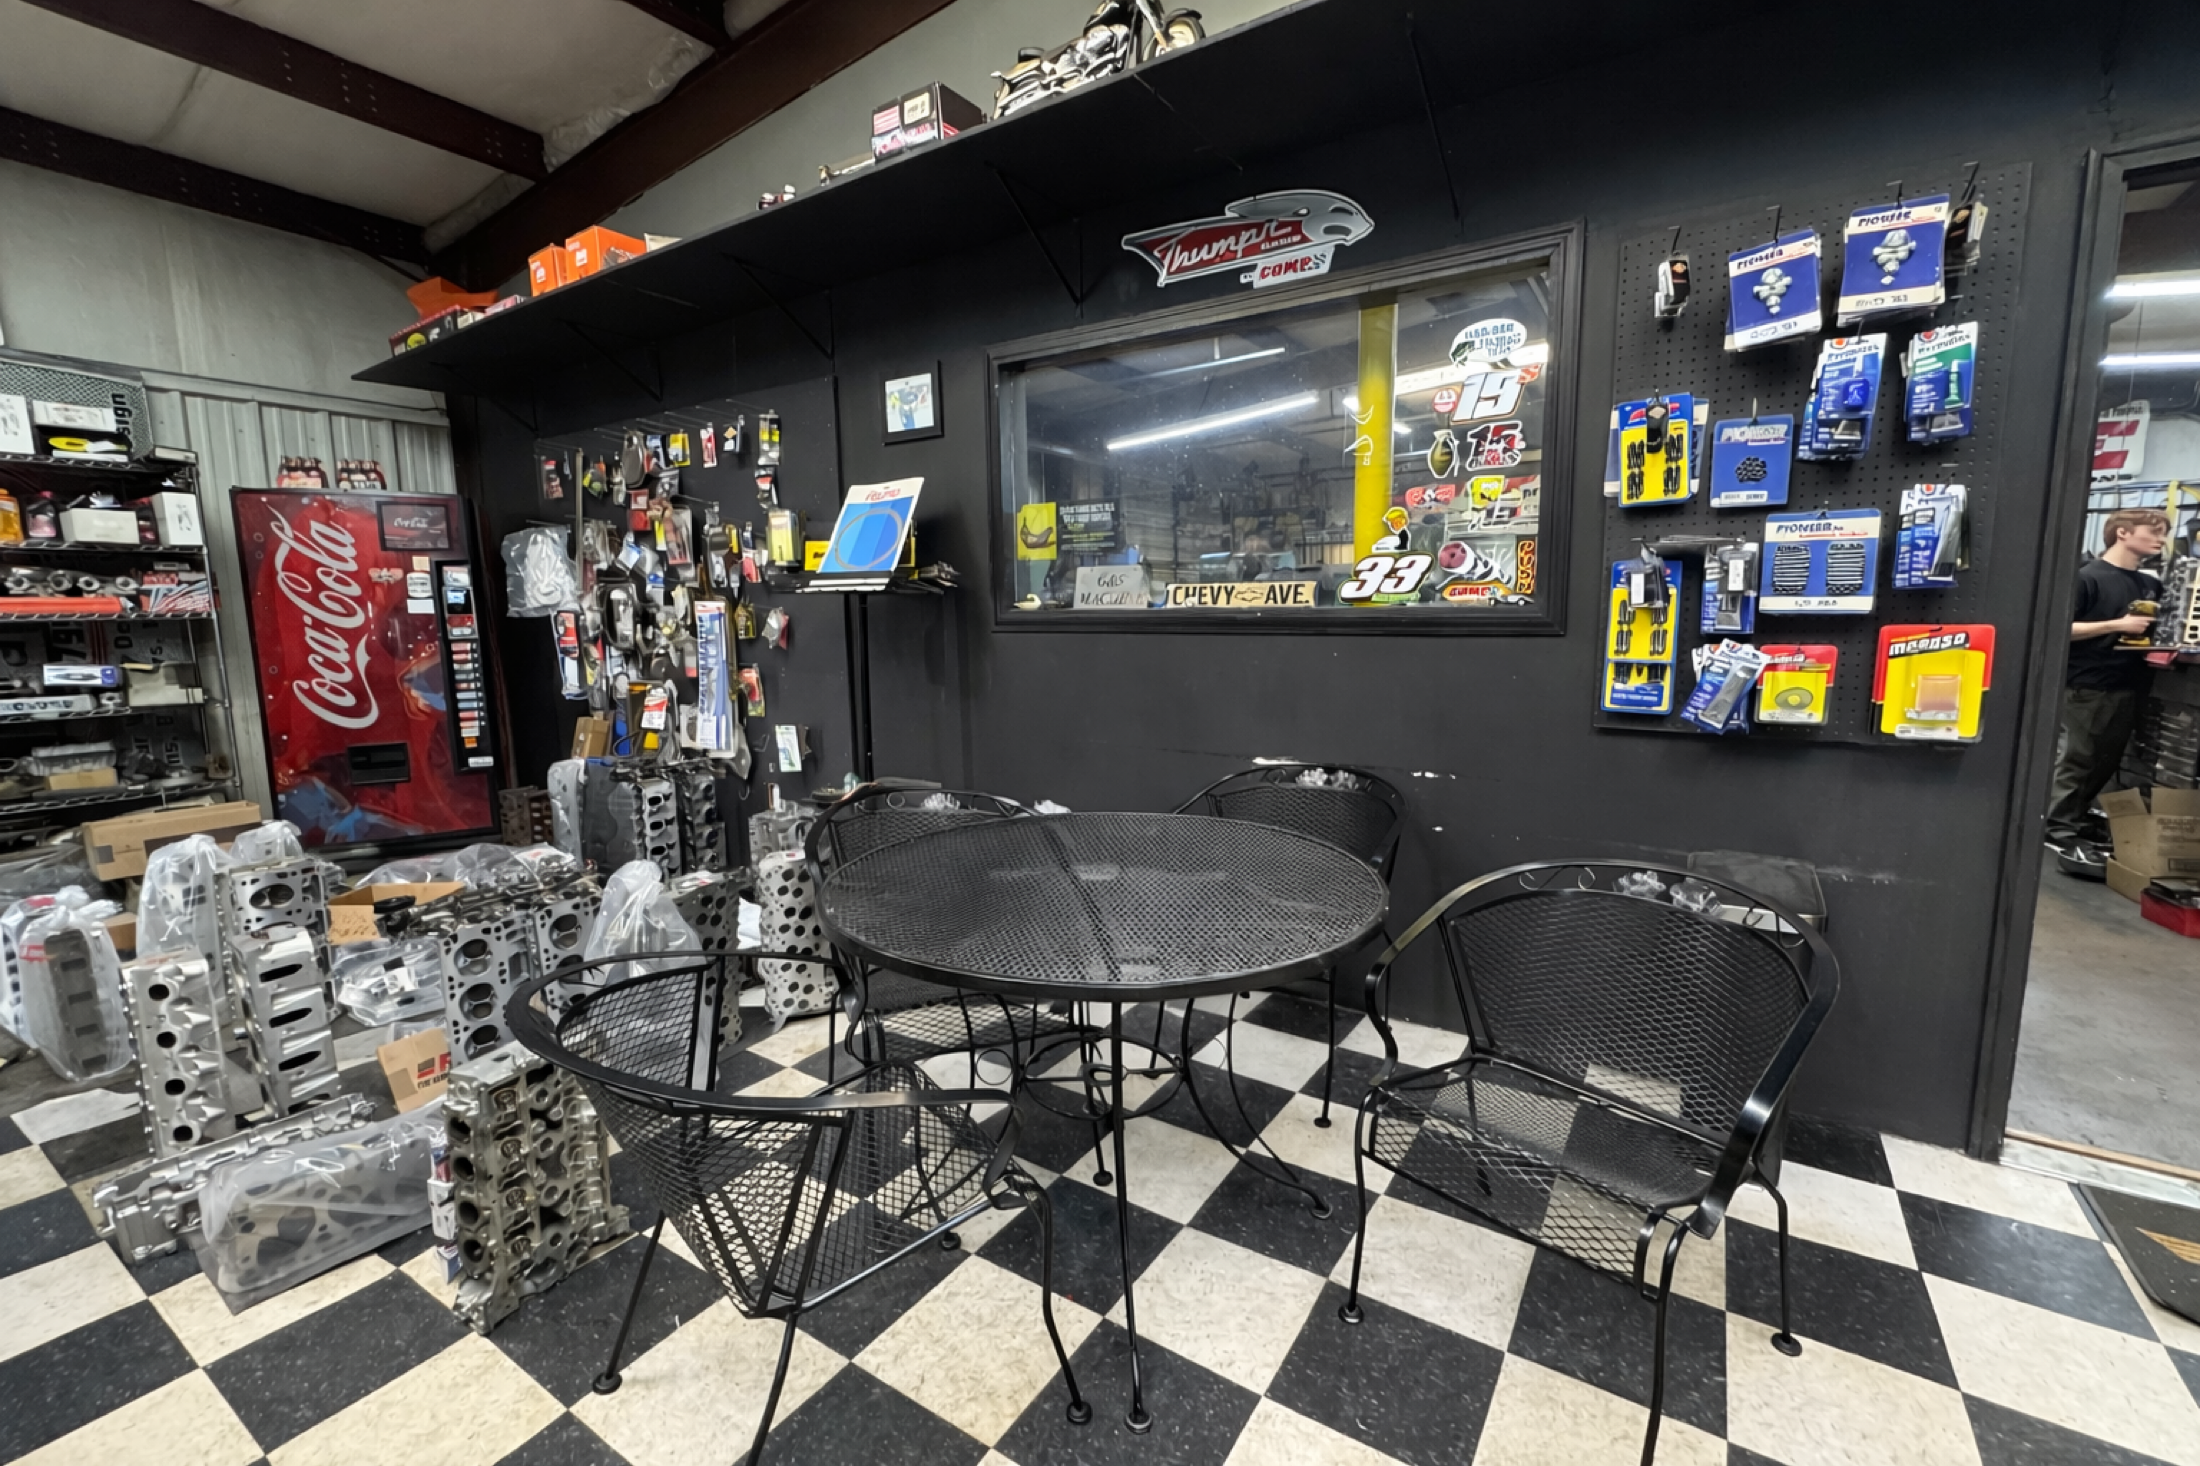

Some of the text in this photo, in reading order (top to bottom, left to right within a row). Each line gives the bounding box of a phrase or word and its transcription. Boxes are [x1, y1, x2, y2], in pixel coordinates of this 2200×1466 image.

[1340, 554, 1433, 598] 33
[1173, 583, 1310, 605] CHEVY AVE.
